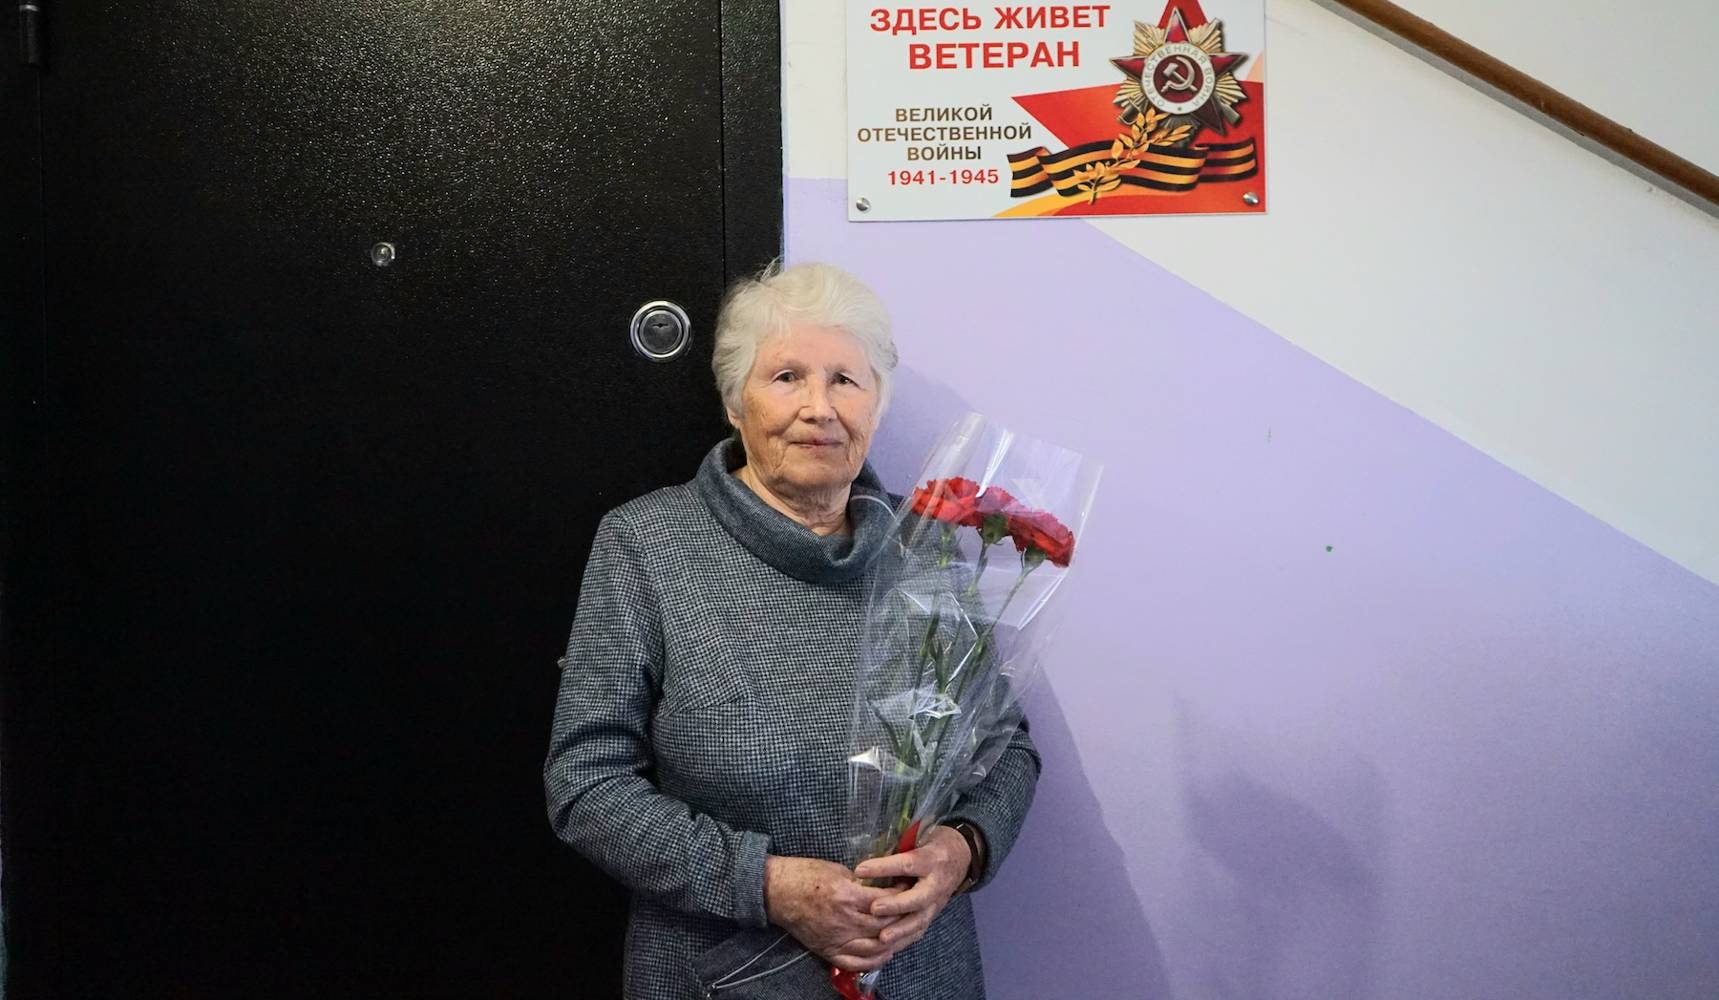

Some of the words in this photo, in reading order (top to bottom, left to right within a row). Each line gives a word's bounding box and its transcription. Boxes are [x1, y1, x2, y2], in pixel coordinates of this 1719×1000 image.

[870, 8, 982, 36] ЗДЕСЬ
[994, 5, 1111, 29] ЖИВЕТ
[909, 41, 1080, 70] ВЕТЕРАН
[895, 104, 993, 122] ВЕЛИКОЙ
[857, 124, 1032, 142] ОТЕЧЕСТВЕННОЙ
[907, 144, 982, 161] ВОЙНЫ
[888, 169, 999, 186] 1941-1945
